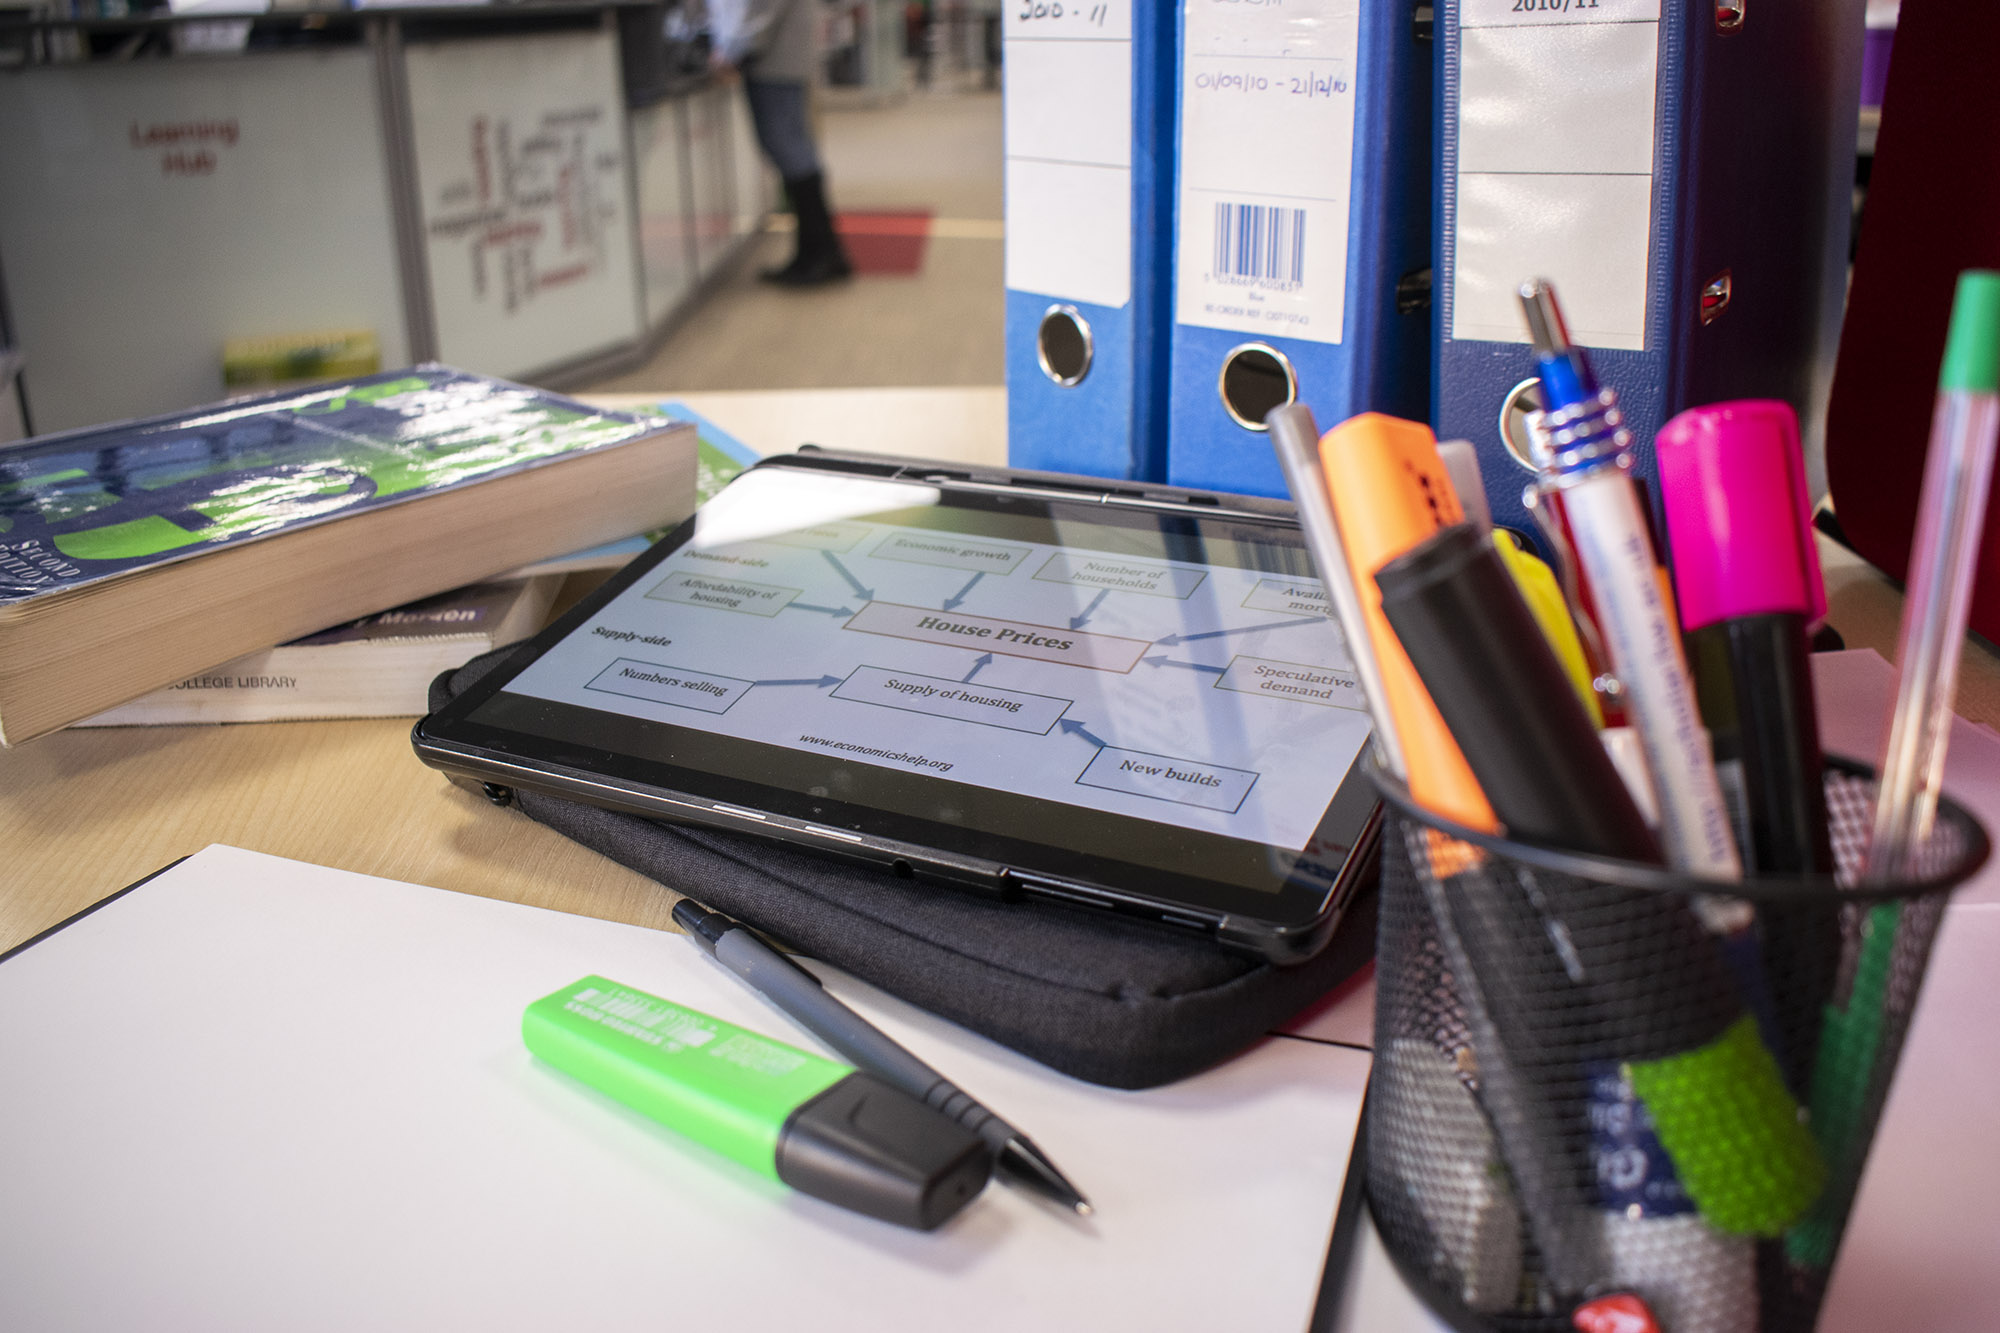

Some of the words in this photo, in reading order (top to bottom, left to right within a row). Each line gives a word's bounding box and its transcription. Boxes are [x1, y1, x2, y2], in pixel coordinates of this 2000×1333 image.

[1511, 0, 1600, 13] 2010/11
[127, 118, 240, 150] Learning
[683, 549, 769, 568] Demand-side
[894, 537, 958, 555] Economic
[959, 546, 1012, 562] growth
[1071, 570, 1159, 591] households
[1084, 560, 1148, 577] Number
[1150, 569, 1168, 580] of
[680, 577, 761, 599] Affordability
[761, 590, 781, 601] of
[689, 591, 742, 608] housing
[591, 625, 672, 648] Supply-side
[915, 615, 993, 640] House
[994, 624, 1075, 652] Prices
[168, 676, 234, 691] OLLEGE
[237, 675, 297, 689] LIBRARY
[618, 667, 681, 688] Numbers
[681, 681, 729, 698] selling
[1253, 664, 1355, 689] Speculative
[883, 678, 939, 699] Supply
[939, 689, 960, 700] of
[957, 691, 1024, 713] housing
[1259, 680, 1334, 699] demand
[799, 733, 955, 773] www.economicshelp.org
[1119, 759, 1162, 776] New
[1164, 767, 1222, 787] builds
